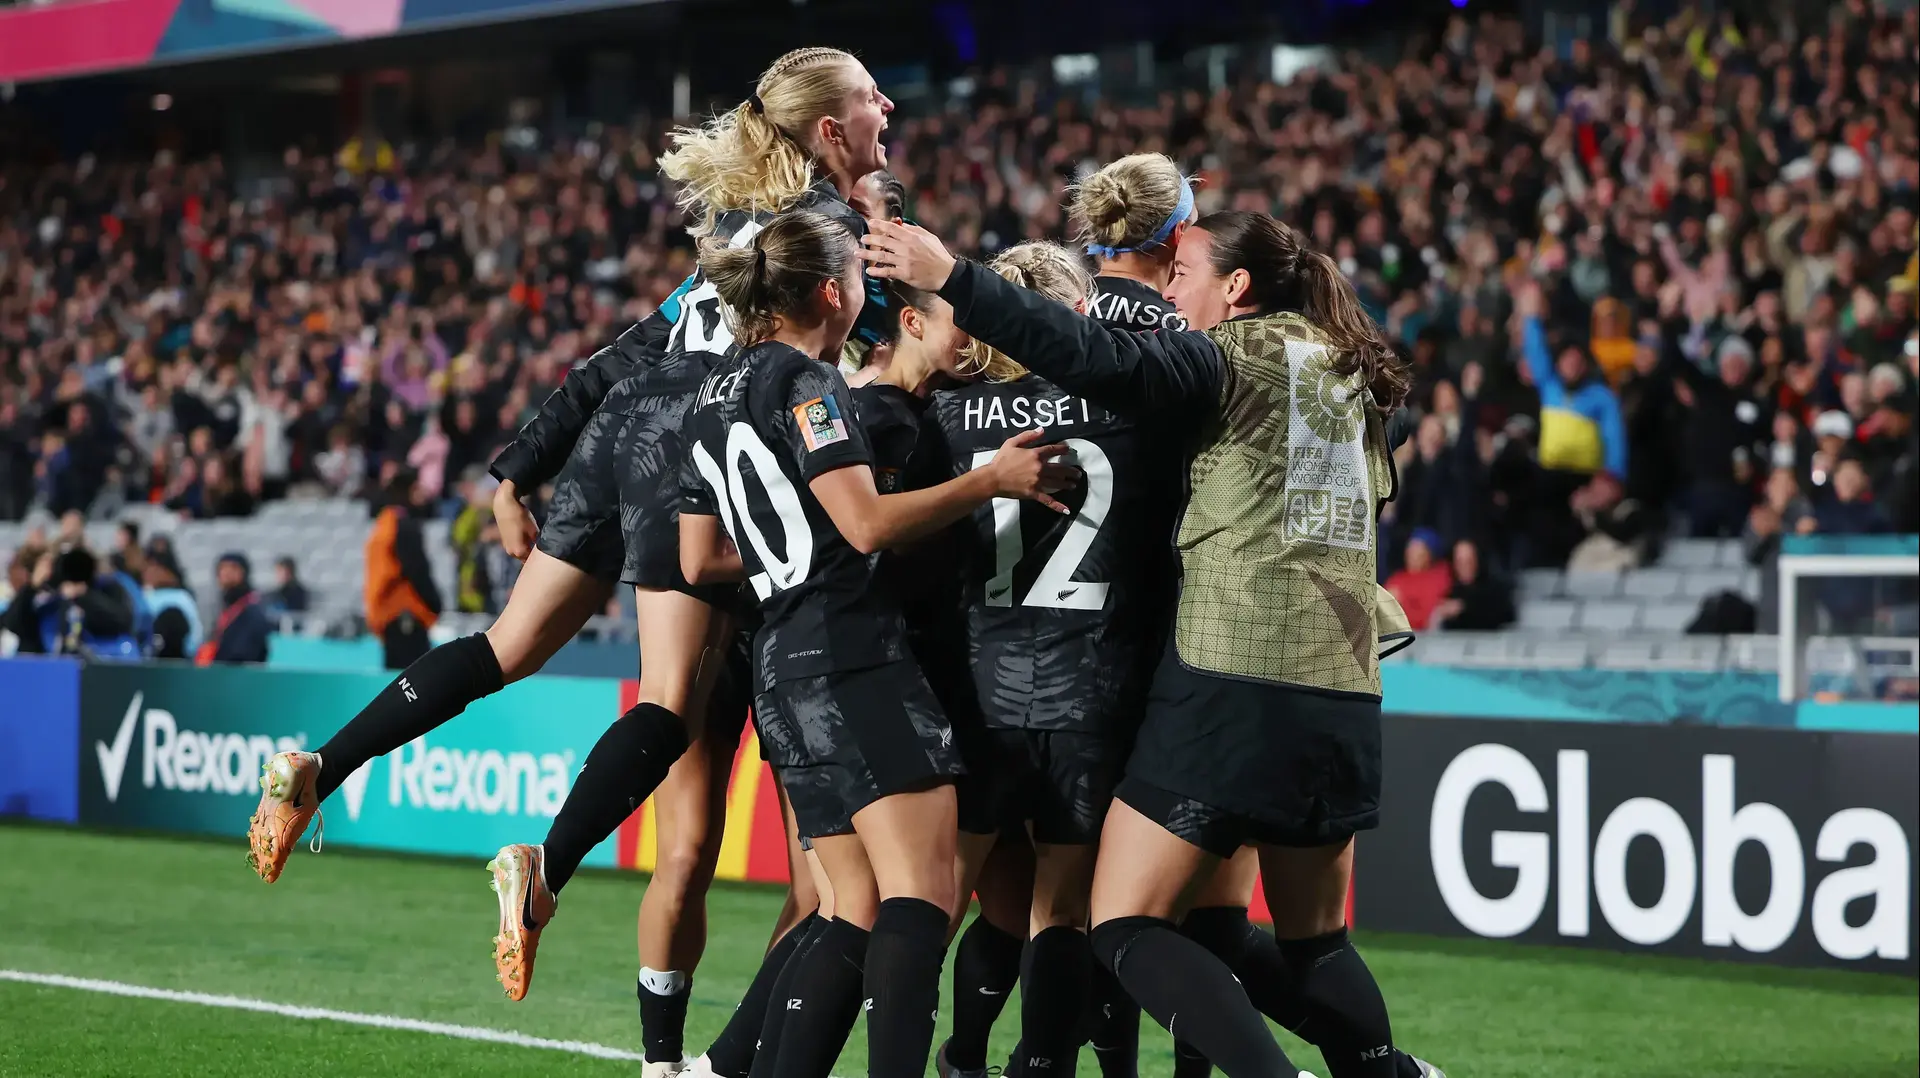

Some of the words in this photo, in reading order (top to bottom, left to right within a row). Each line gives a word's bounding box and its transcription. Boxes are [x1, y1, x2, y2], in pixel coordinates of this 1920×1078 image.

[1291, 461, 1350, 474] WOMEN'S
[1290, 472, 1333, 485] WORLD
[971, 438, 1113, 610] 12
[398, 677, 418, 703] NZ
[1430, 743, 1910, 961] Globa
[1361, 1045, 1388, 1061] NZ
[1029, 1057, 1052, 1069] NZ
